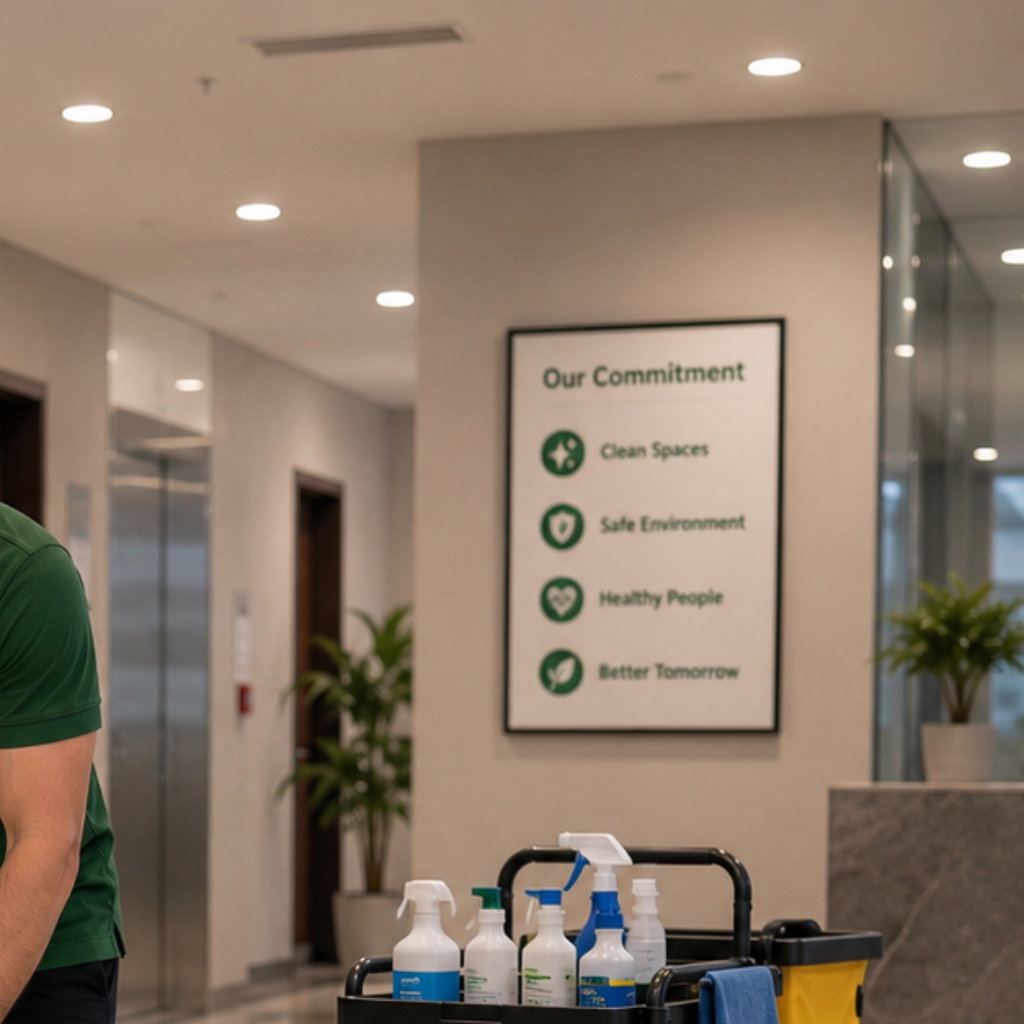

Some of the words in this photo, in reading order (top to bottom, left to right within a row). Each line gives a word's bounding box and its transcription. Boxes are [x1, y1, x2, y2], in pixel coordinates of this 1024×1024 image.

[542, 367, 585, 389] Our
[592, 362, 745, 388] Commitment
[600, 443, 646, 460] Clean
[652, 441, 709, 462] Spaces
[600, 515, 636, 534] Safe
[641, 514, 745, 533] Environment
[599, 589, 662, 611] Healthy
[668, 588, 724, 610] People
[599, 663, 649, 680] Better
[655, 662, 740, 680] Tomorrow
